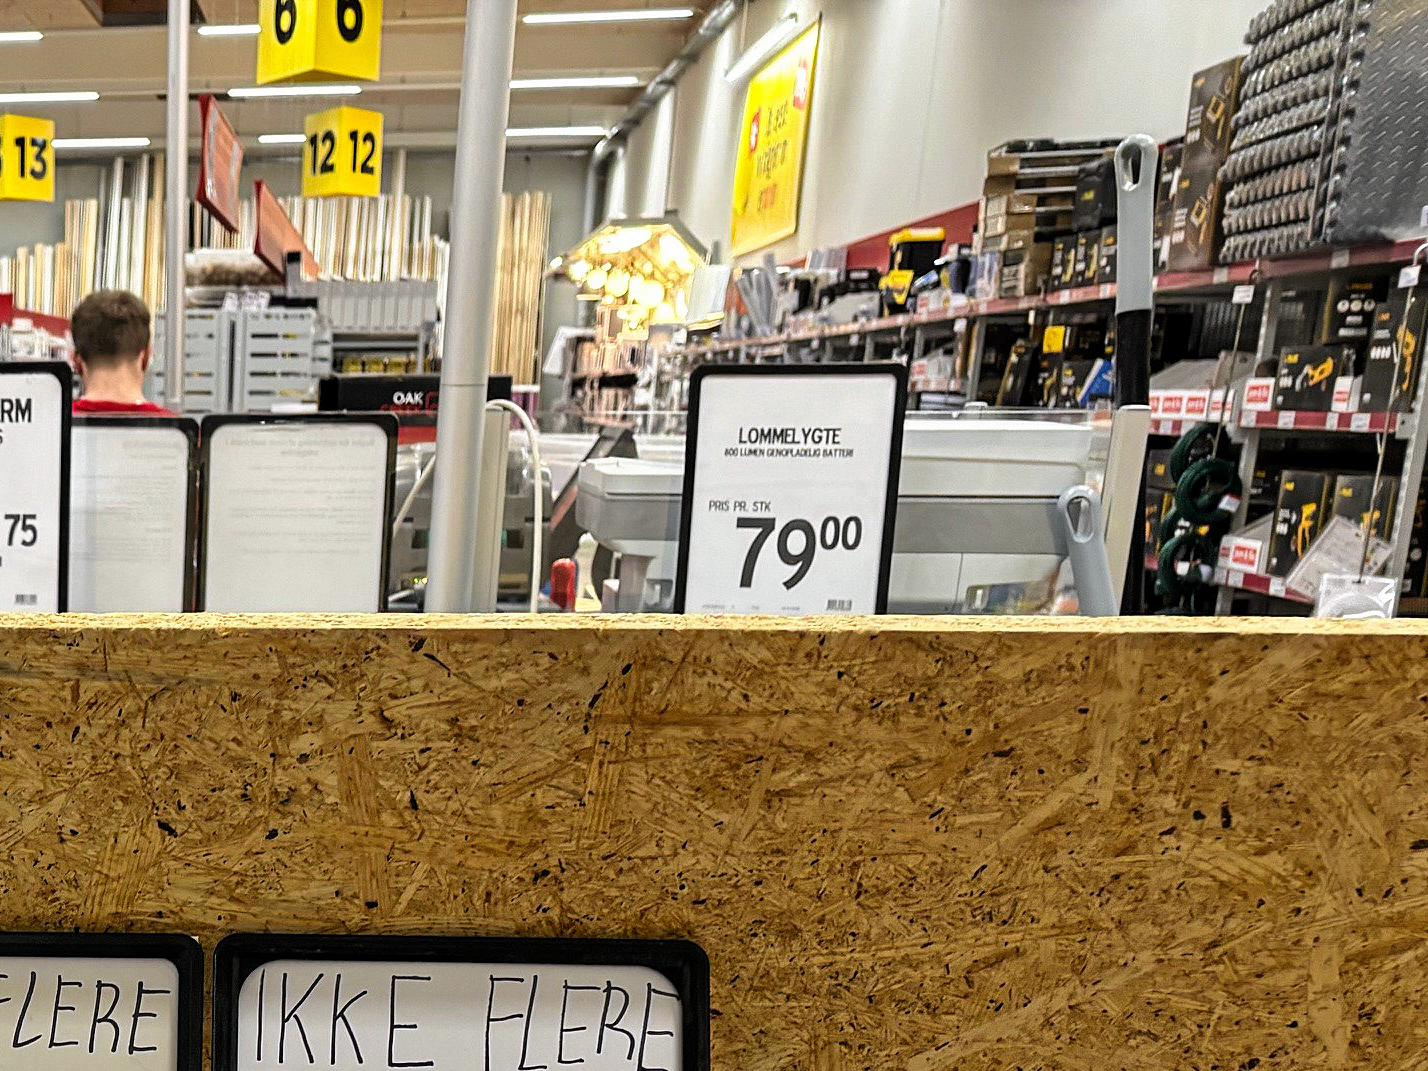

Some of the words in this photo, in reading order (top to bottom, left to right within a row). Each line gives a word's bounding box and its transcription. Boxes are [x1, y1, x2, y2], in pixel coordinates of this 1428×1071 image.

[275, 0, 297, 45] 6
[336, 0, 363, 43] 6
[15, 135, 47, 180] 13
[309, 130, 336, 176] 12
[349, 130, 376, 175] 12
[392, 391, 424, 405] OAK
[739, 427, 841, 445] LOMMELYGTE
[708, 500, 729, 512] PRIS
[733, 500, 748, 512] PR.
[752, 501, 771, 512] STK
[256, 968, 434, 1068] IKKE
